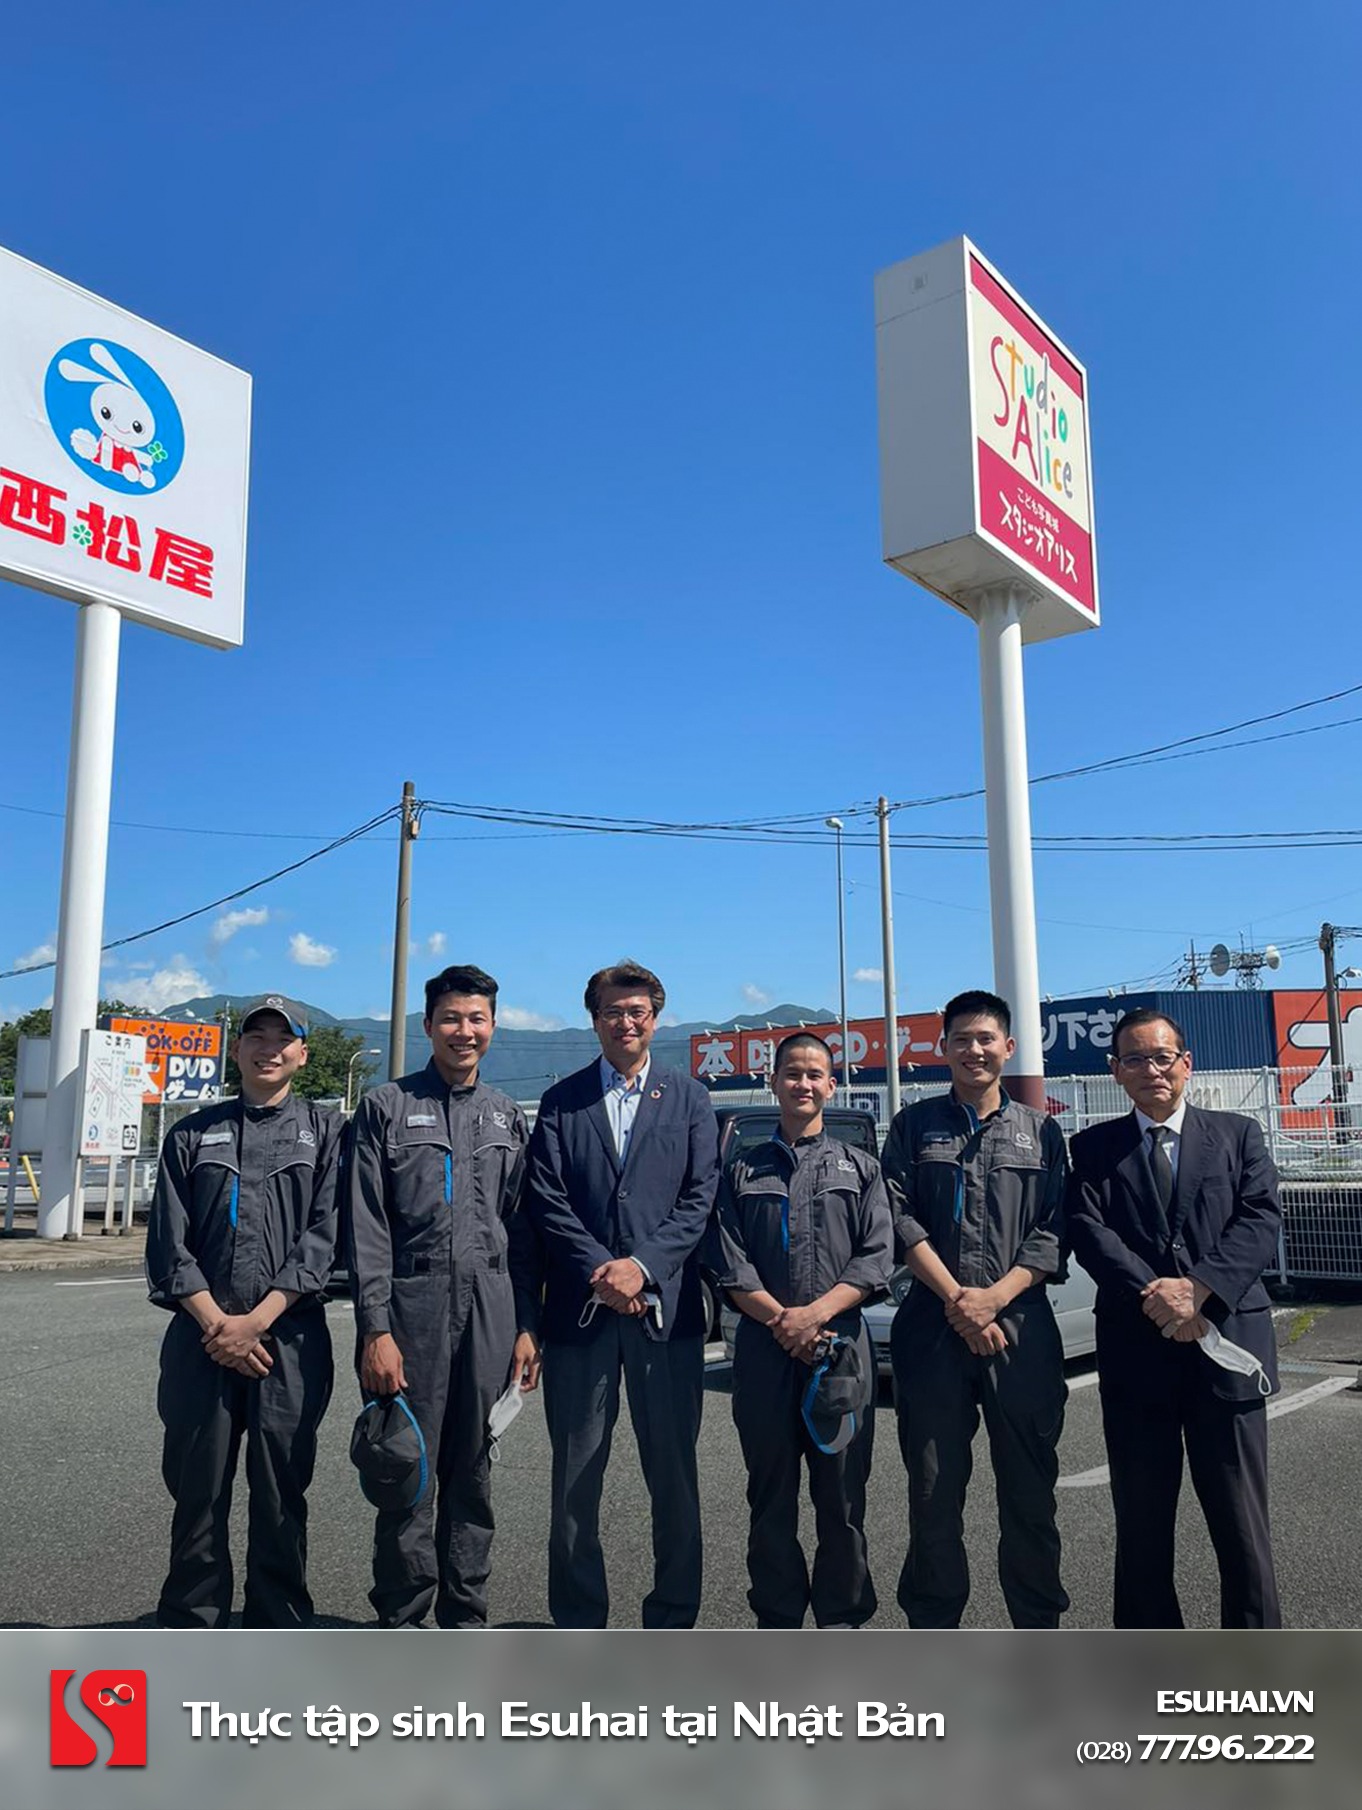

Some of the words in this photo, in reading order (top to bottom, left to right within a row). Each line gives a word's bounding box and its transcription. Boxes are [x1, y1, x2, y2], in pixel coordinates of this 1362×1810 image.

[990, 337, 1068, 442] Studio
[1012, 395, 1074, 500] Alice
[0, 467, 214, 598] 西松屋
[998, 491, 1078, 583] スタジオアリス
[168, 1056, 216, 1079] DVD
[697, 1037, 734, 1075] 本
[1041, 1009, 1125, 1051] り下さ
